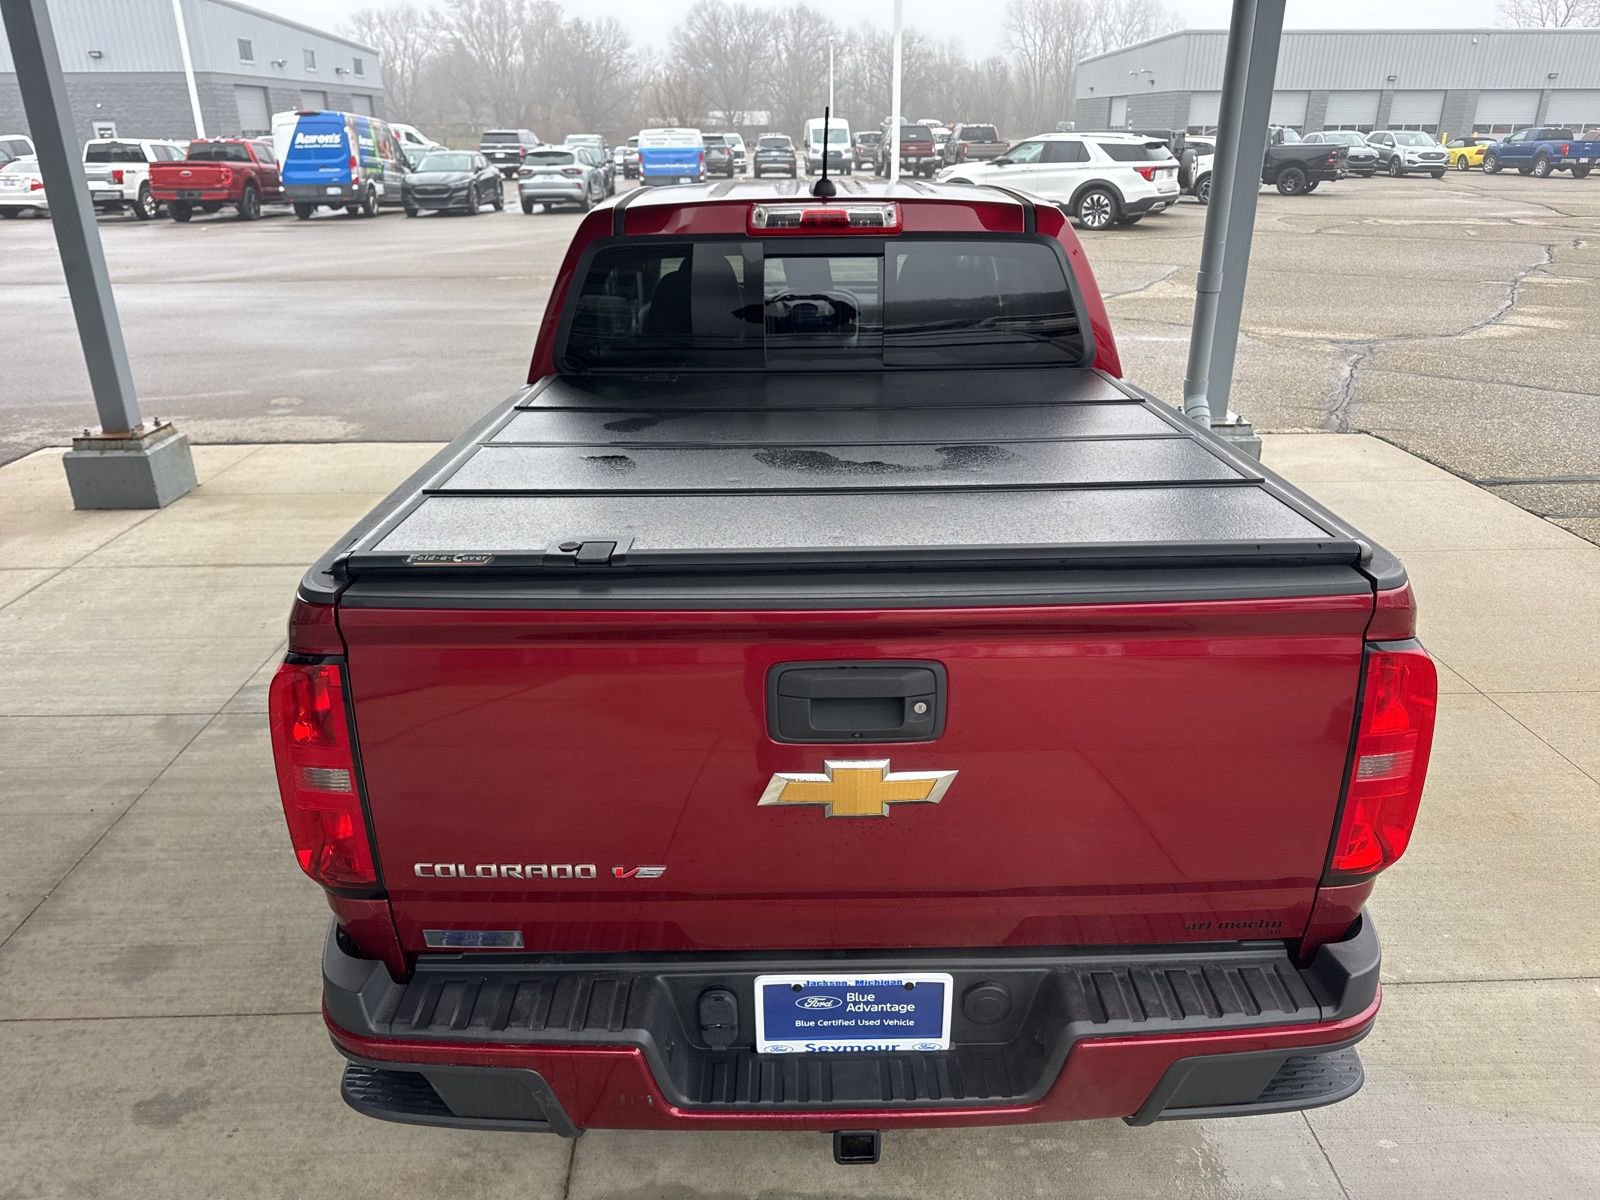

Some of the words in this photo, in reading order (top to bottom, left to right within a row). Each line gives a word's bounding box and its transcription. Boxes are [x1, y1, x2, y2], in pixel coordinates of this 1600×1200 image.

[294, 132, 342, 145] Aaron's
[406, 553, 489, 563] Fold-a-Cover
[413, 863, 597, 879] COLORADO
[612, 864, 667, 879] V6
[855, 979, 903, 987] Michigan
[804, 996, 834, 1008] Ford
[846, 992, 876, 1002] Blue
[846, 1002, 915, 1014] Advantage
[795, 1019, 815, 1027] Blue
[817, 1018, 855, 1027] Certified
[857, 1018, 880, 1027] Used
[883, 1018, 915, 1027] Vehicle
[805, 1043, 900, 1053] Seymour
